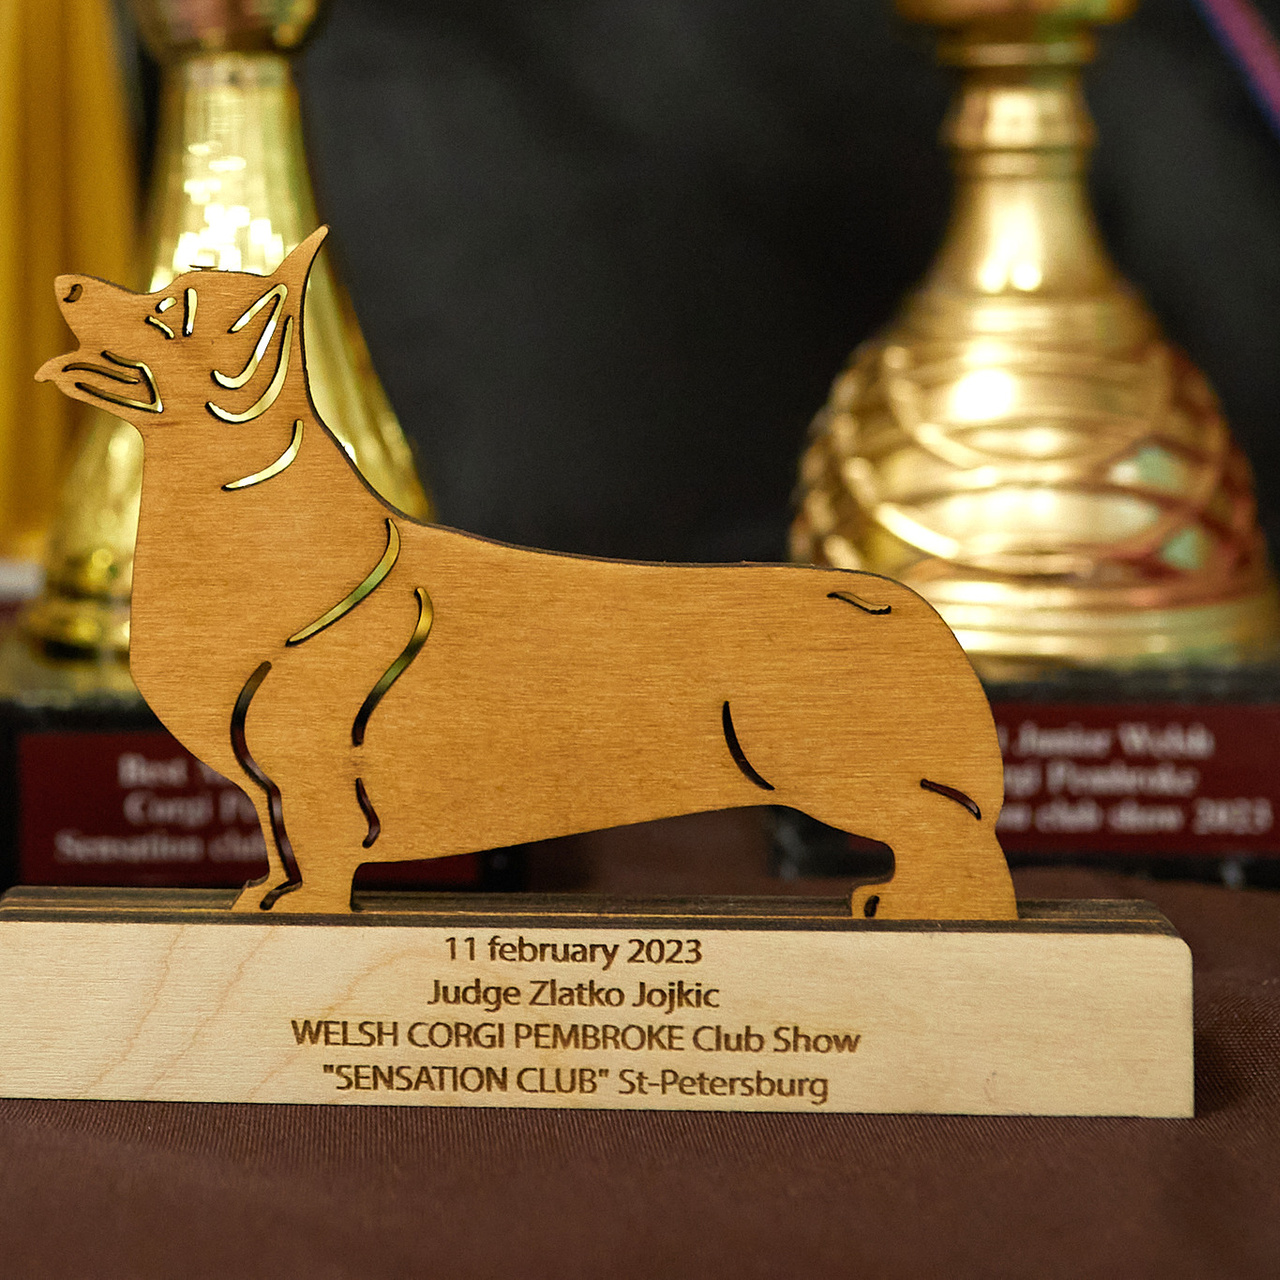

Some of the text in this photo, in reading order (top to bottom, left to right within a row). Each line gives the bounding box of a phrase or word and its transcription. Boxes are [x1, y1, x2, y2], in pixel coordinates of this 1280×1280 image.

[118, 753, 187, 788] Best
[123, 790, 213, 827] Corgi
[443, 935, 702, 971] 11 february 2023
[427, 978, 720, 1014] Judge Zlatko Jojkic
[291, 1020, 861, 1053] WELSH CORGI PEMBROKE Club Show
[323, 1064, 828, 1106] "SENSATION CLUB" St-Petersburg
